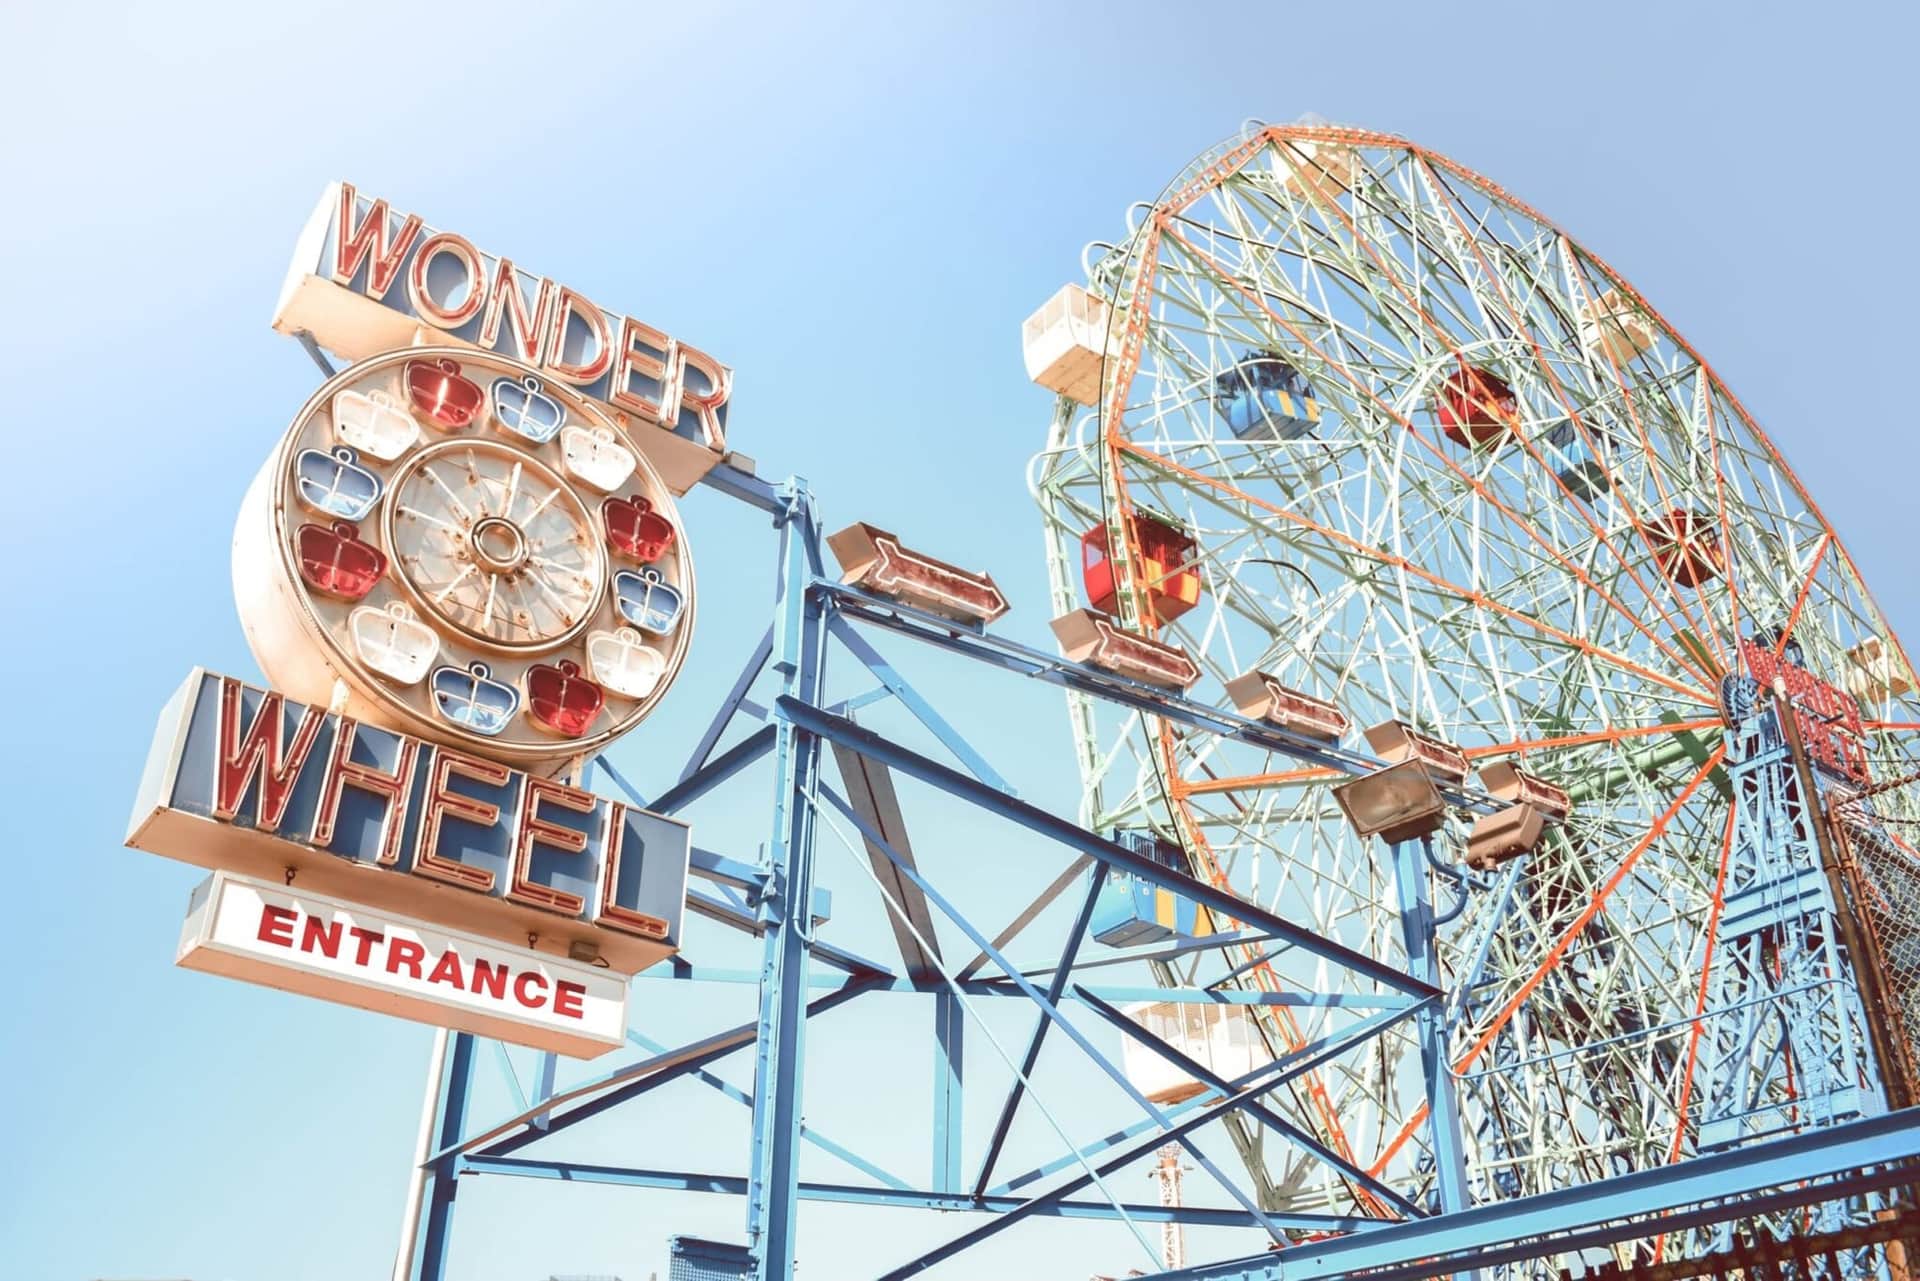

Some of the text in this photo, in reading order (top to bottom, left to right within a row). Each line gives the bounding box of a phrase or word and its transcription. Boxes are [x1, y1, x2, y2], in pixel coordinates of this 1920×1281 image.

[334, 182, 732, 449] WONDER
[216, 677, 669, 938] WHEEL
[257, 904, 586, 1019] ENTRANCE
